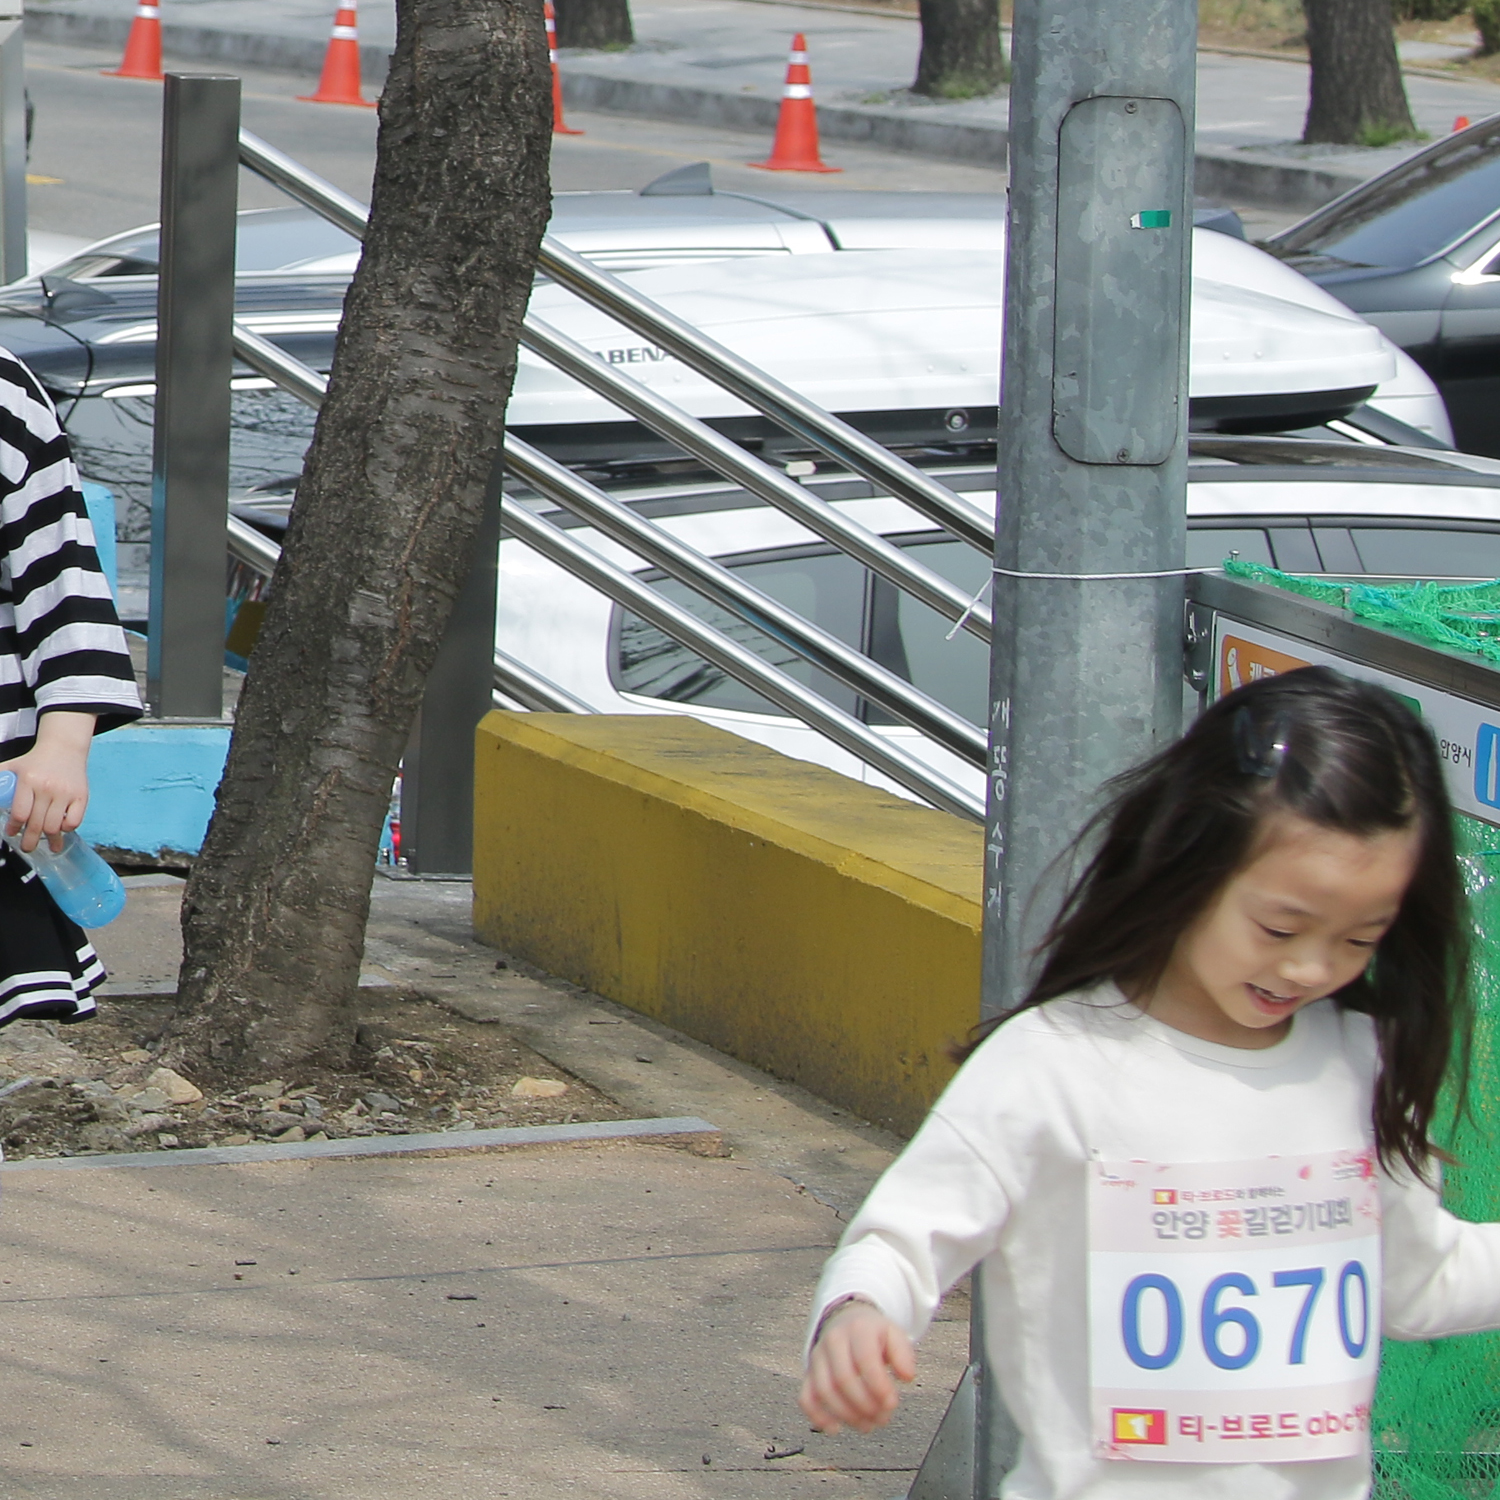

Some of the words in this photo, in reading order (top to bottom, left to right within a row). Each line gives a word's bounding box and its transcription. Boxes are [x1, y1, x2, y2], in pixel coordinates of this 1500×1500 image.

[1440, 739, 1472, 768] 안양시
[1152, 1210, 1210, 1240] 안양
[1216, 1197, 1353, 1238] 꽃길걷기대회
[1122, 1260, 1369, 1370] 0670
